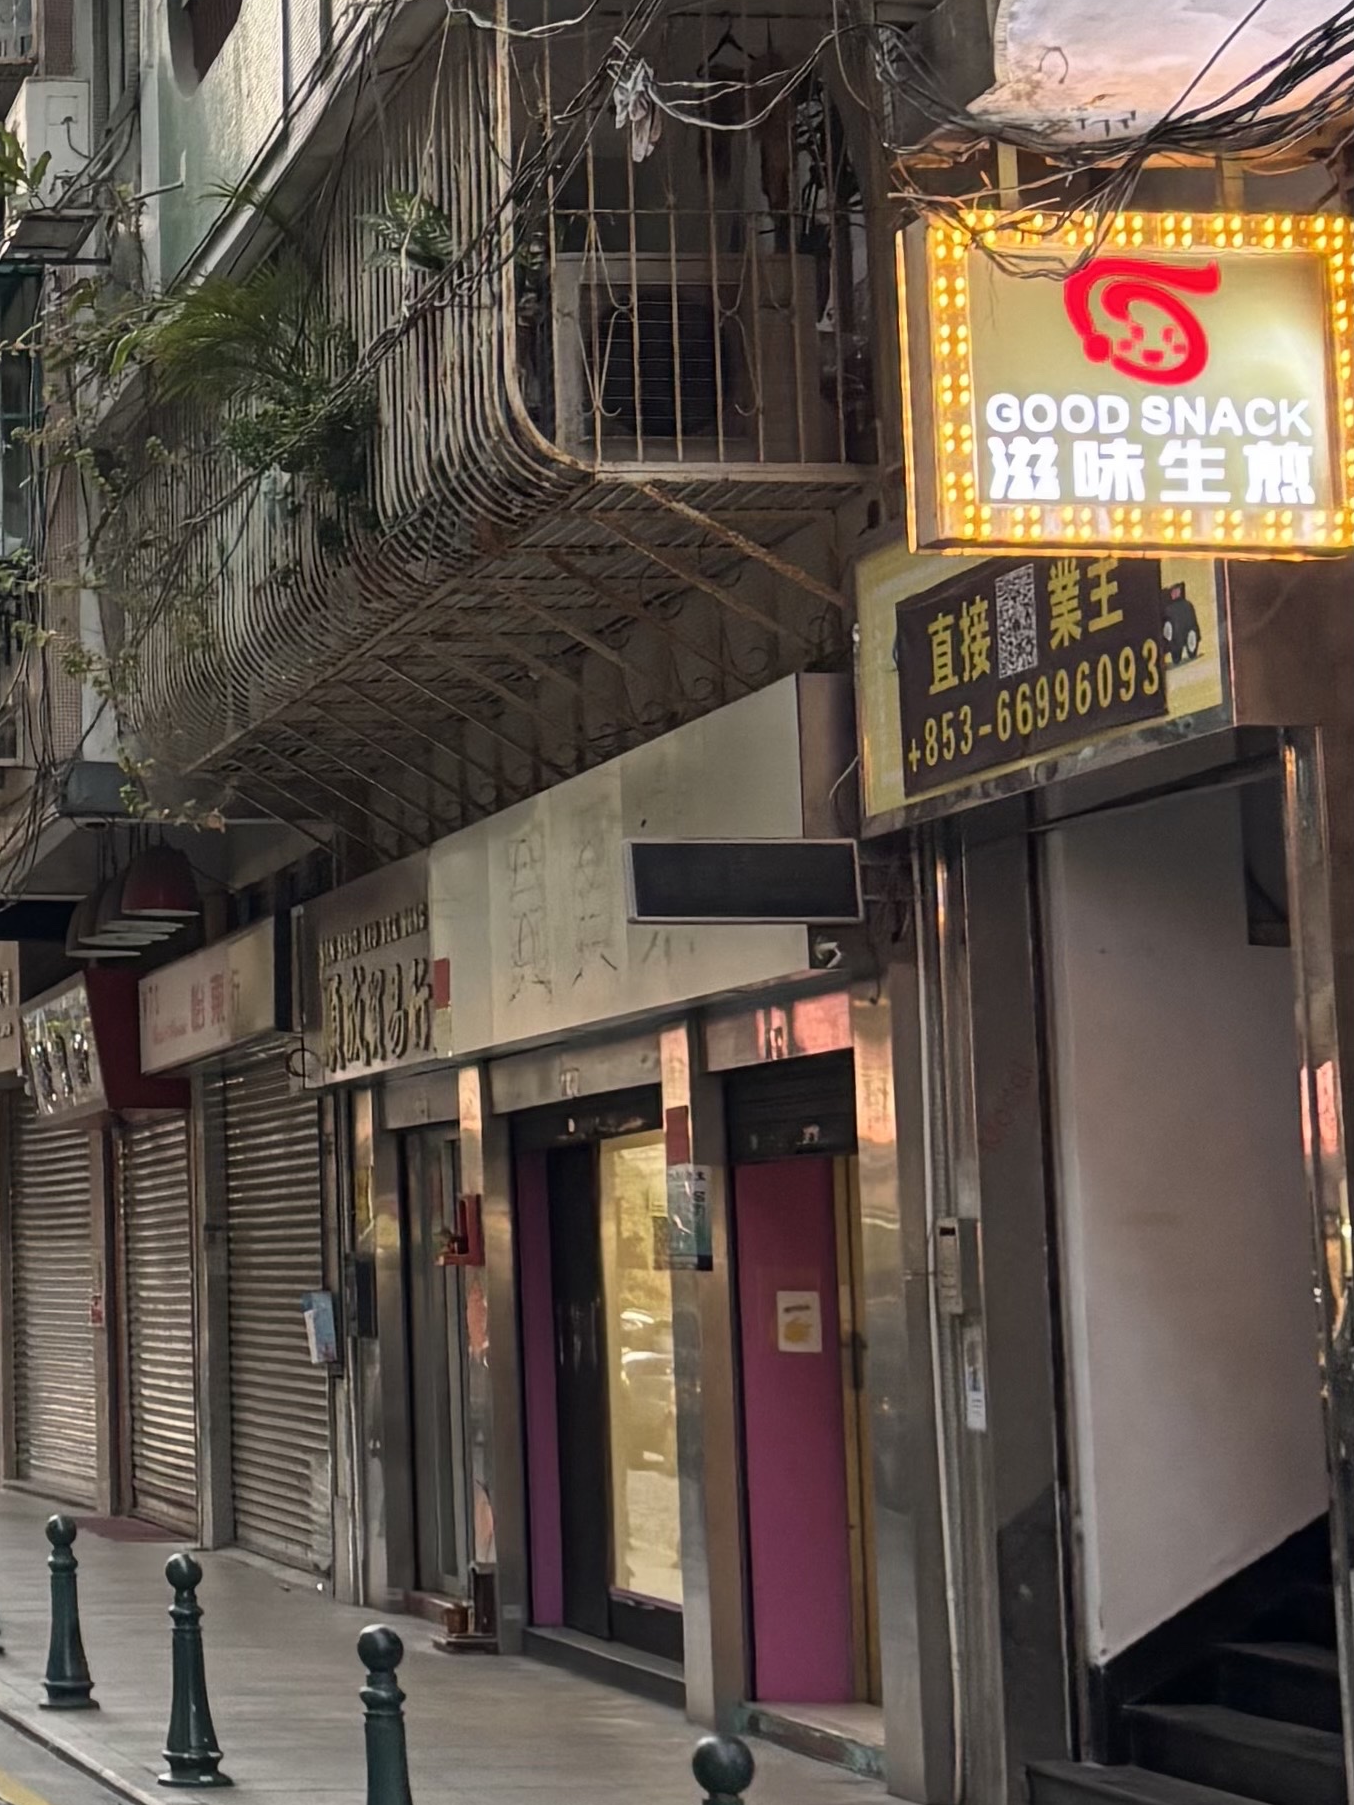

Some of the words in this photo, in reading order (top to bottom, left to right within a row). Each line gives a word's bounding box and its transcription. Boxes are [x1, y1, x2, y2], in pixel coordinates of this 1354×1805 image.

[986, 393, 1130, 433] GOOD
[1141, 396, 1312, 437] SNACK
[928, 594, 991, 695] 直接
[908, 639, 1160, 773] +853-66996093
